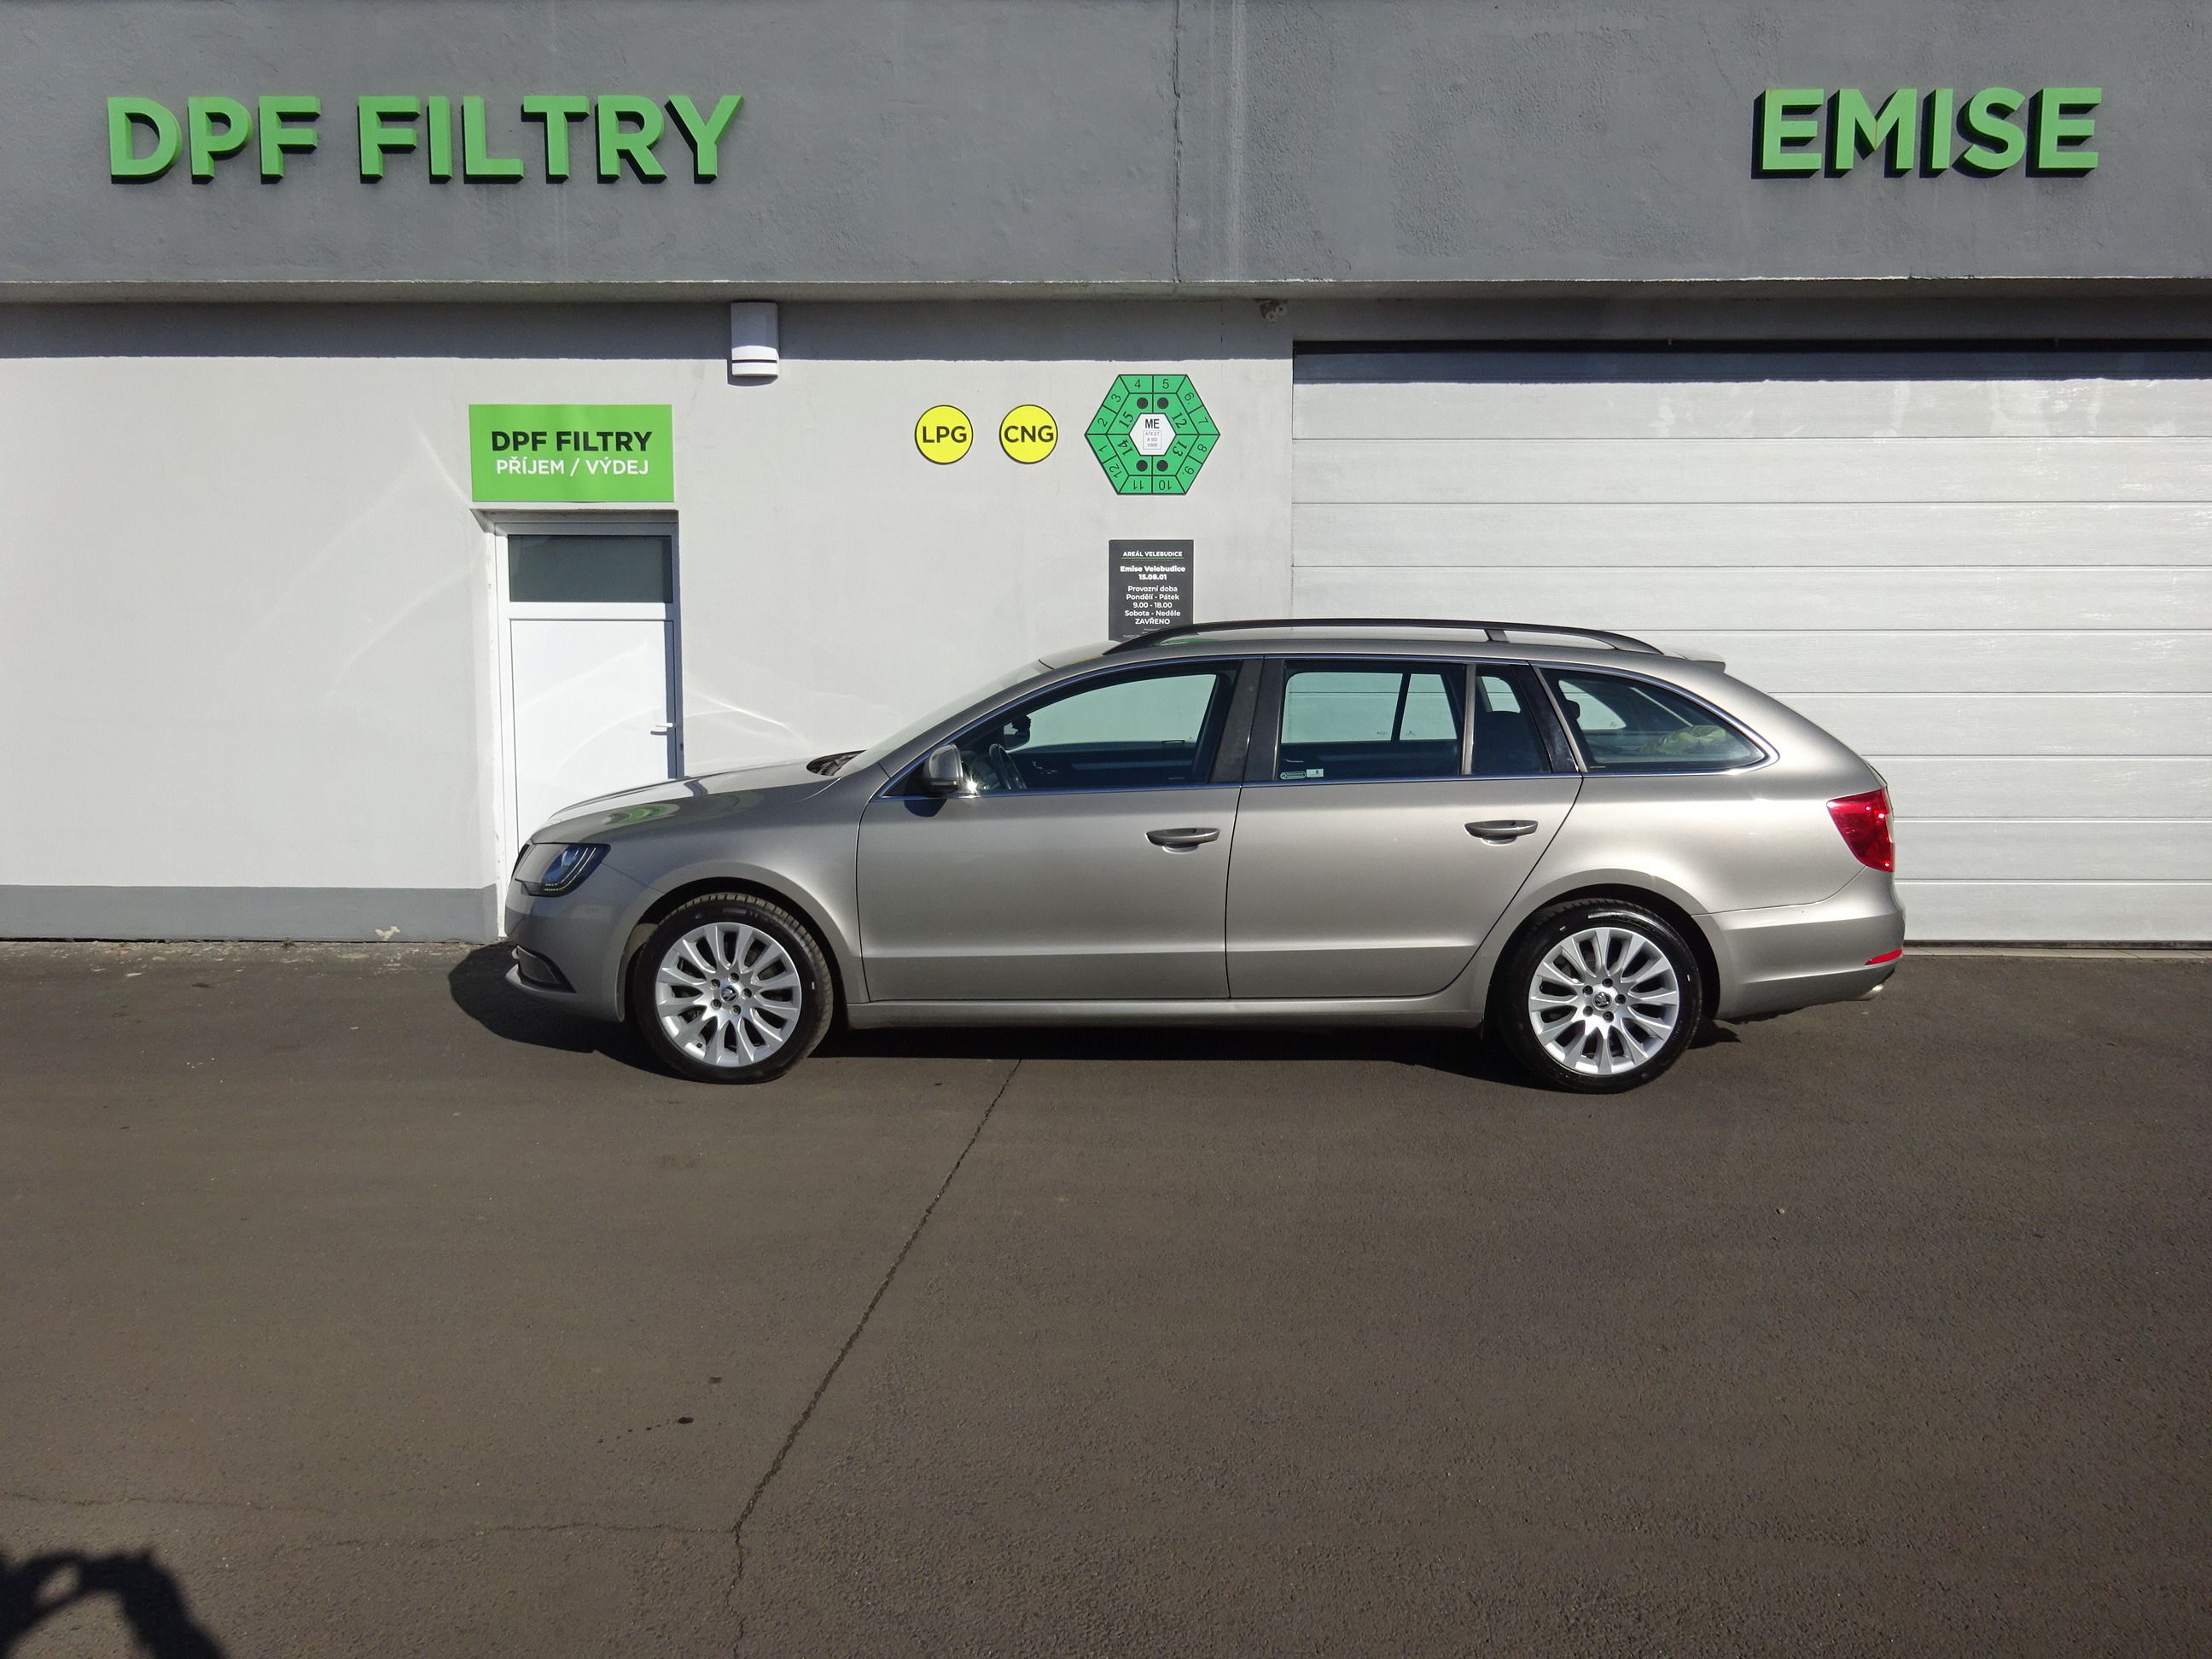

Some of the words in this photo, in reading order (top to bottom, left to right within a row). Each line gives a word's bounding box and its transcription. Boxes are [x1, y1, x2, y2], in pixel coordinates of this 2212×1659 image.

[107, 96, 321, 183] DPF
[357, 95, 743, 184] FILTRY
[1751, 87, 2103, 179] EMISE
[1134, 379, 1141, 389] 4
[1162, 379, 1169, 389] 5
[1097, 418, 1108, 427] 2
[1119, 411, 1133, 428] 15
[1144, 418, 1160, 429] ME
[1172, 412, 1187, 428] 12
[492, 431, 548, 451] DPF
[556, 431, 653, 451] FILTRY
[923, 425, 967, 443] LPG
[1004, 425, 1054, 443] CNG
[1117, 439, 1133, 456] 14
[1172, 440, 1187, 457] 13
[497, 456, 564, 474] PŘÍJEM
[570, 457, 580, 477] /
[585, 457, 649, 475] VÝDEJ
[1109, 463, 1122, 478] 12
[1132, 480, 1144, 490] 11
[1158, 480, 1172, 490] 10
